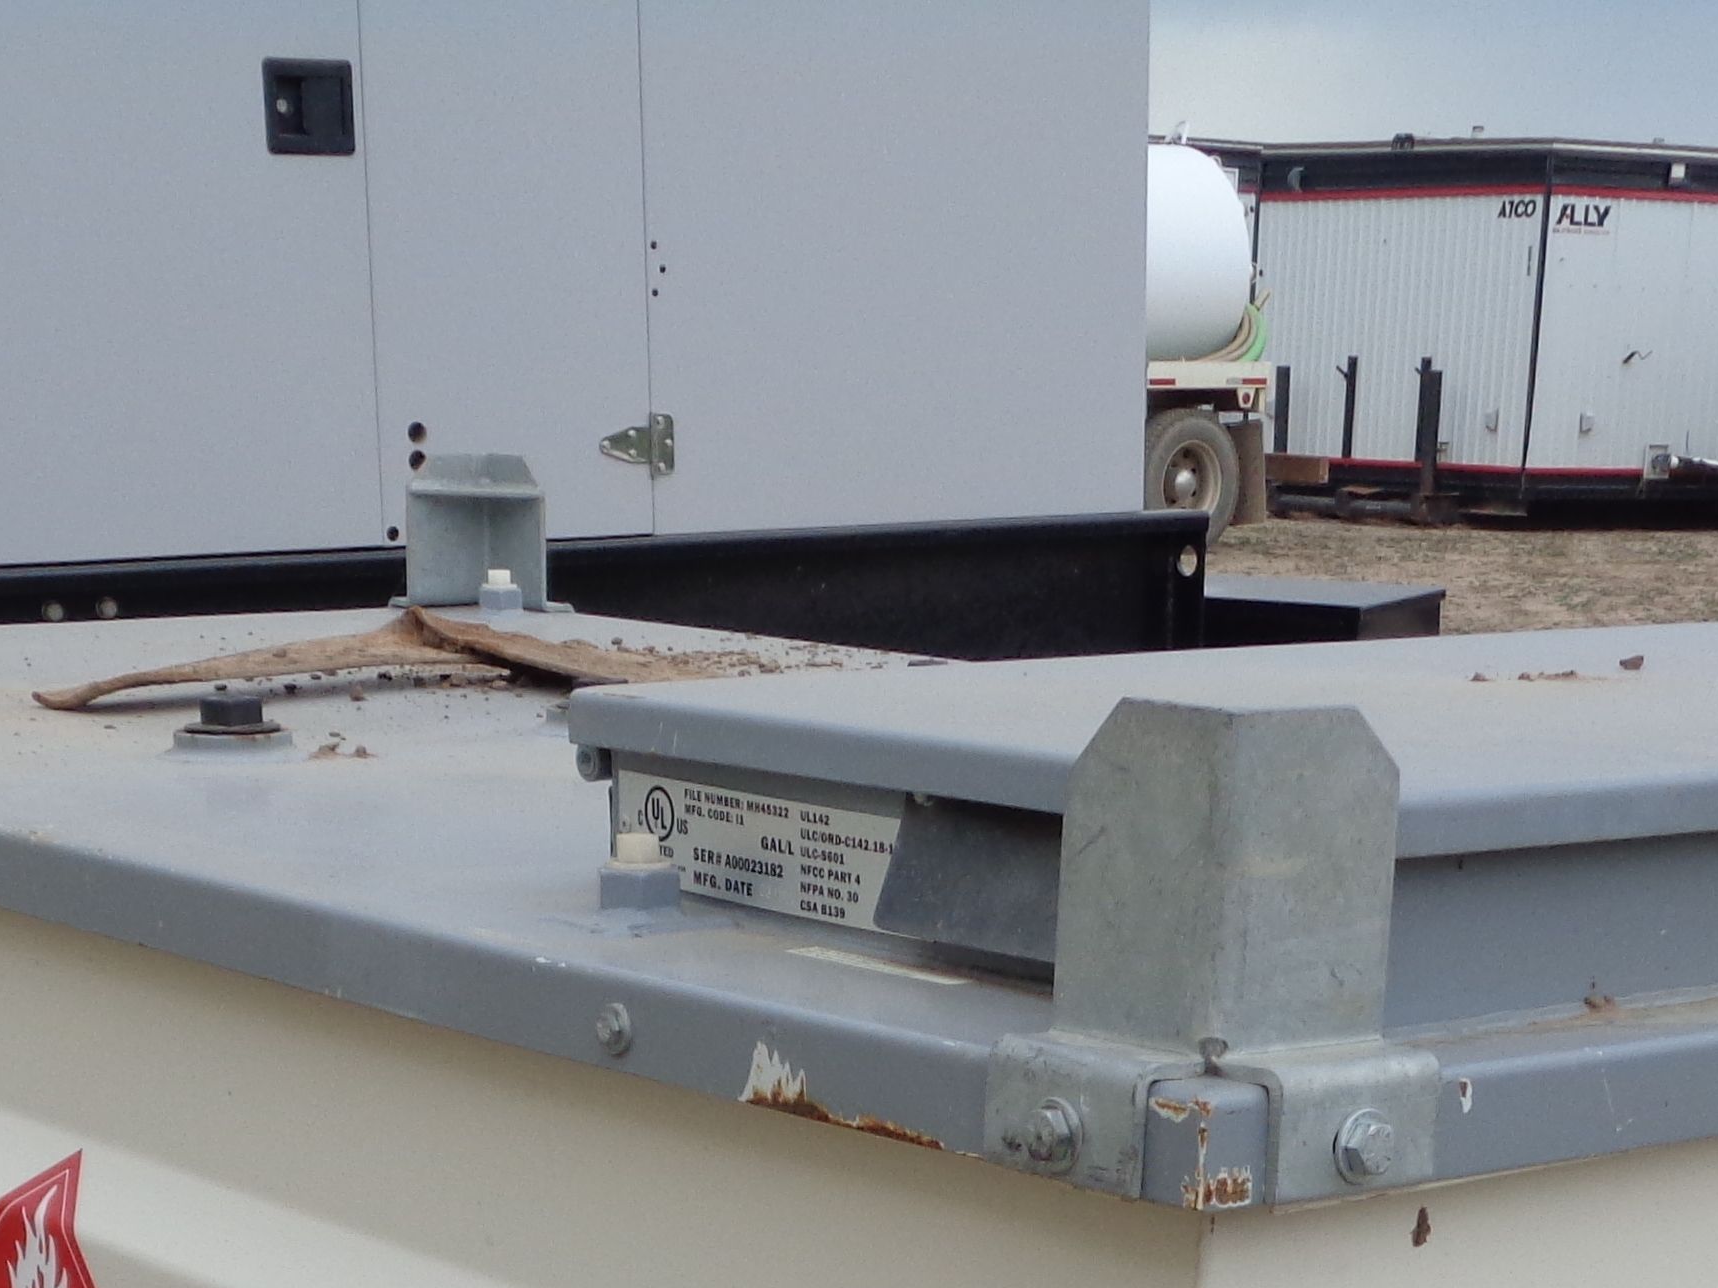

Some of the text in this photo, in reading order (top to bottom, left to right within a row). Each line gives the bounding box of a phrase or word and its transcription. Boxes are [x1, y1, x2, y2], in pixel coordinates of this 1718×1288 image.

[1497, 199, 1537, 218] ATCO
[1556, 203, 1611, 227] ALLY
[684, 788, 702, 802] FILE
[704, 792, 744, 810] NUMBER:
[676, 817, 689, 835] US
[800, 810, 830, 826] UL142
[693, 870, 753, 897] MFG. DATE
[827, 871, 852, 886] PART
[854, 873, 861, 886] 4
[800, 881, 859, 903] NFPA NO. 30
[800, 899, 818, 913] CSA
